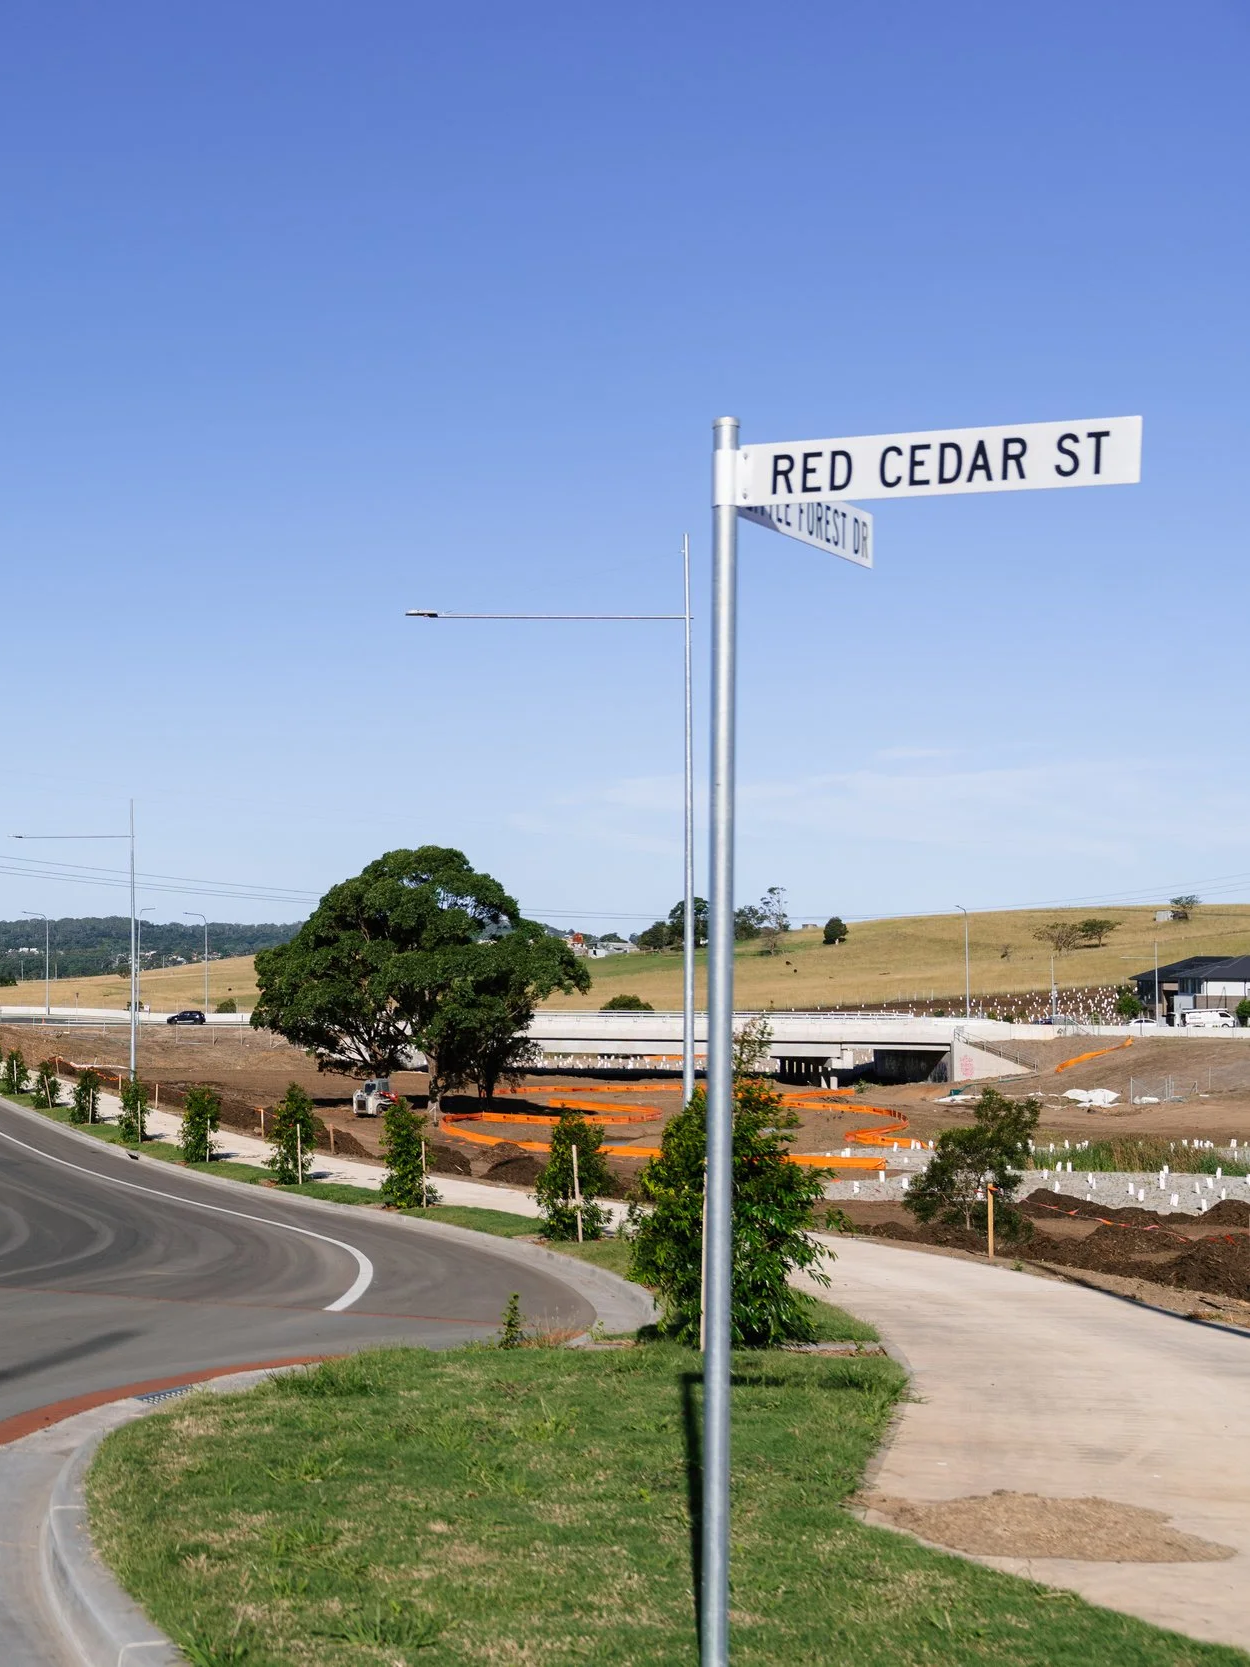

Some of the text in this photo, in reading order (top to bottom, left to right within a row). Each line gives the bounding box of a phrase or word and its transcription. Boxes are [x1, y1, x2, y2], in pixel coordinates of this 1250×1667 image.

[771, 430, 1110, 495] RED CEDAR ST
[797, 501, 847, 550] FOREST
[853, 517, 869, 560] DR
